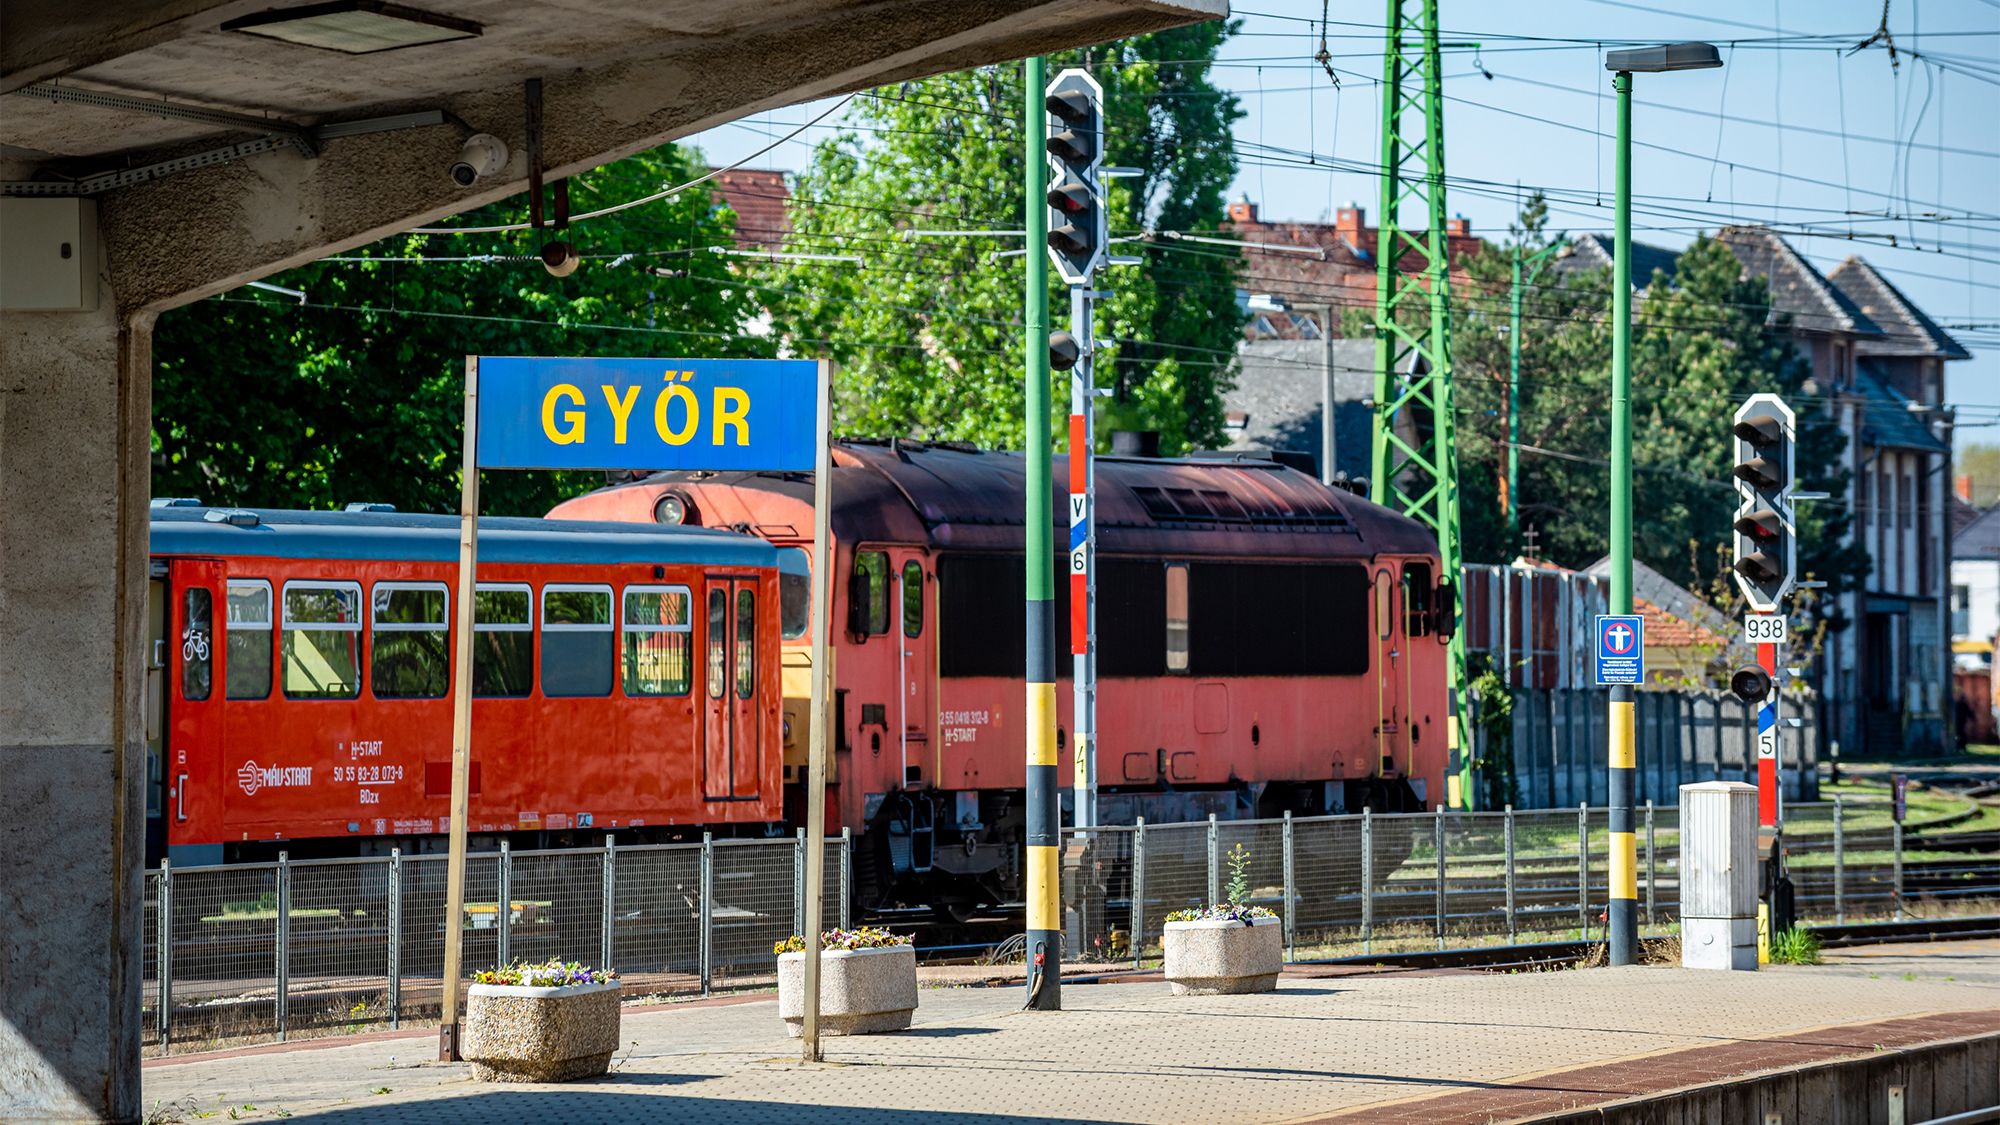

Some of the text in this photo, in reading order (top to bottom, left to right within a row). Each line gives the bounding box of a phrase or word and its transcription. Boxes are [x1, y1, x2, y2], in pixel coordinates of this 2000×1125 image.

[541, 370, 751, 446] GYŐR
[1073, 498, 1083, 517] V
[1073, 552, 1084, 570] 6
[1748, 619, 1783, 638] 938
[945, 728, 976, 743] H-START
[351, 741, 383, 758] H-START
[1761, 736, 1773, 754] 5
[333, 766, 403, 782] 50 55 83-28 073-8
[360, 789, 379, 804] BDzx
